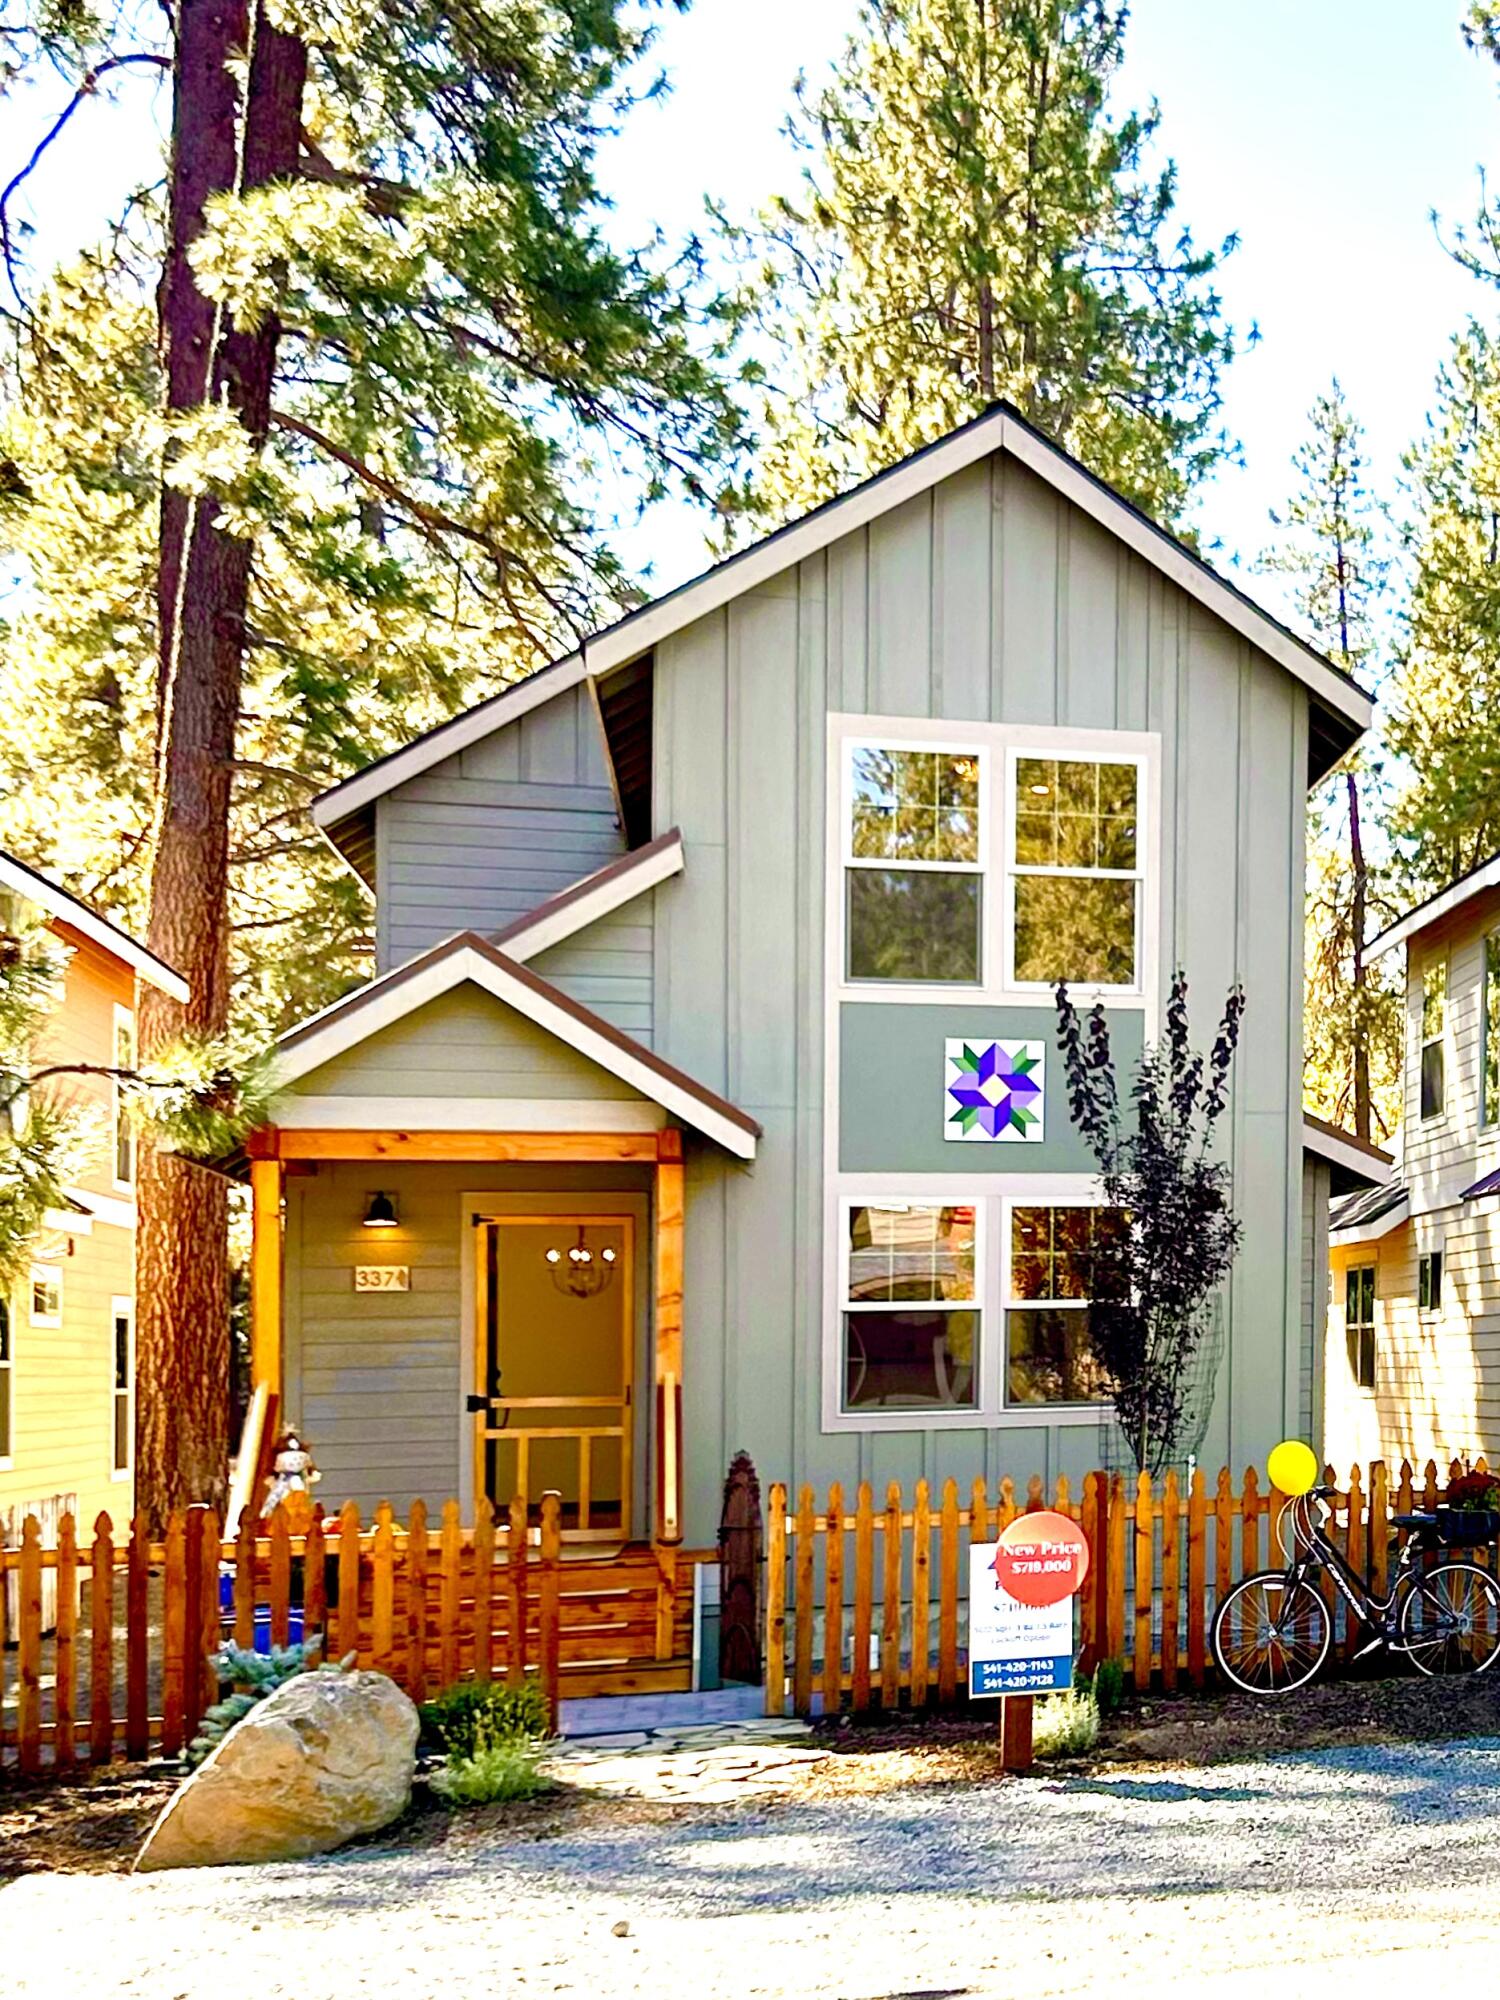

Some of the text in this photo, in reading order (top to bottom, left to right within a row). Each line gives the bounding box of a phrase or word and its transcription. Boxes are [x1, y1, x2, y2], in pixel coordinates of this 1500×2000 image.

[1002, 1541, 1083, 1557] New Price
[982, 1659, 1054, 1675] 541-420-1143
[983, 1674, 1055, 1690] 541-420-7128
